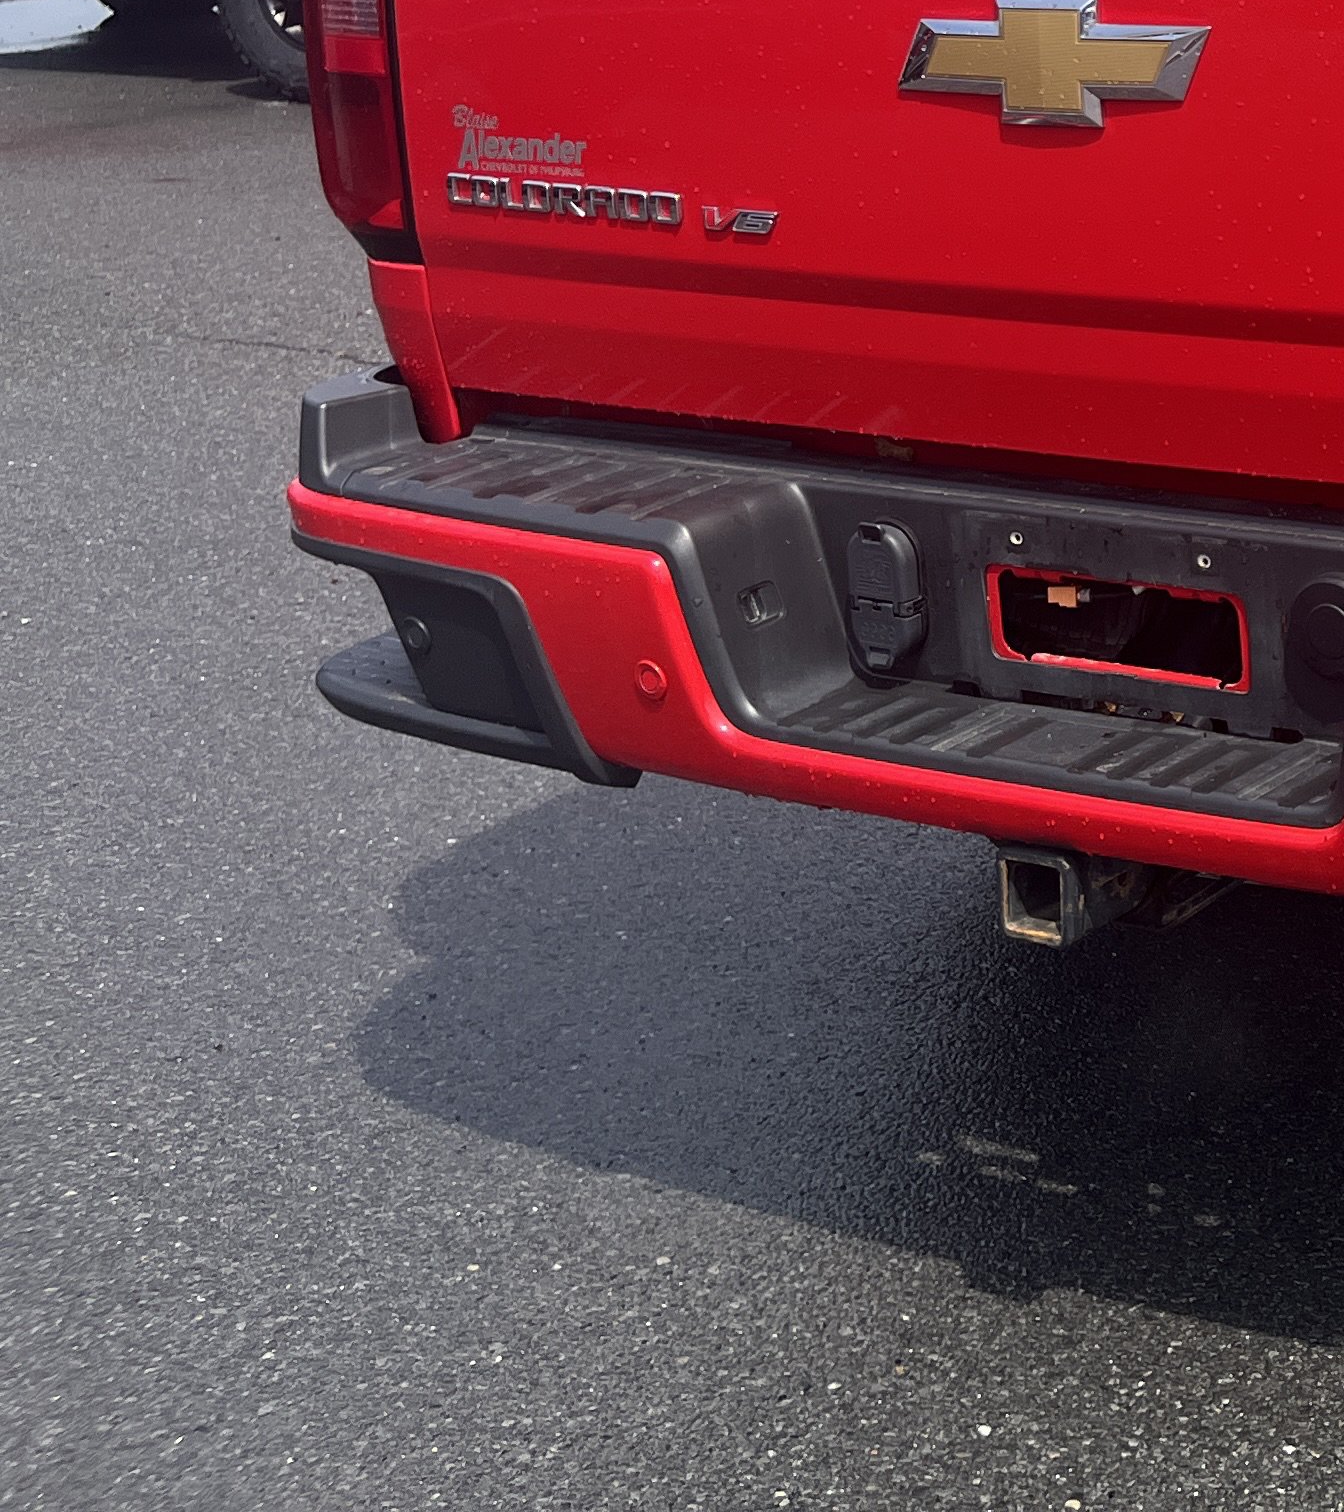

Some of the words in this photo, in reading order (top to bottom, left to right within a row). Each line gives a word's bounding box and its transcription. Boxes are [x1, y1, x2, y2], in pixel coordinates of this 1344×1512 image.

[458, 128, 587, 170] Alexander
[446, 172, 682, 225] COLORADO
[701, 205, 781, 236] V6
